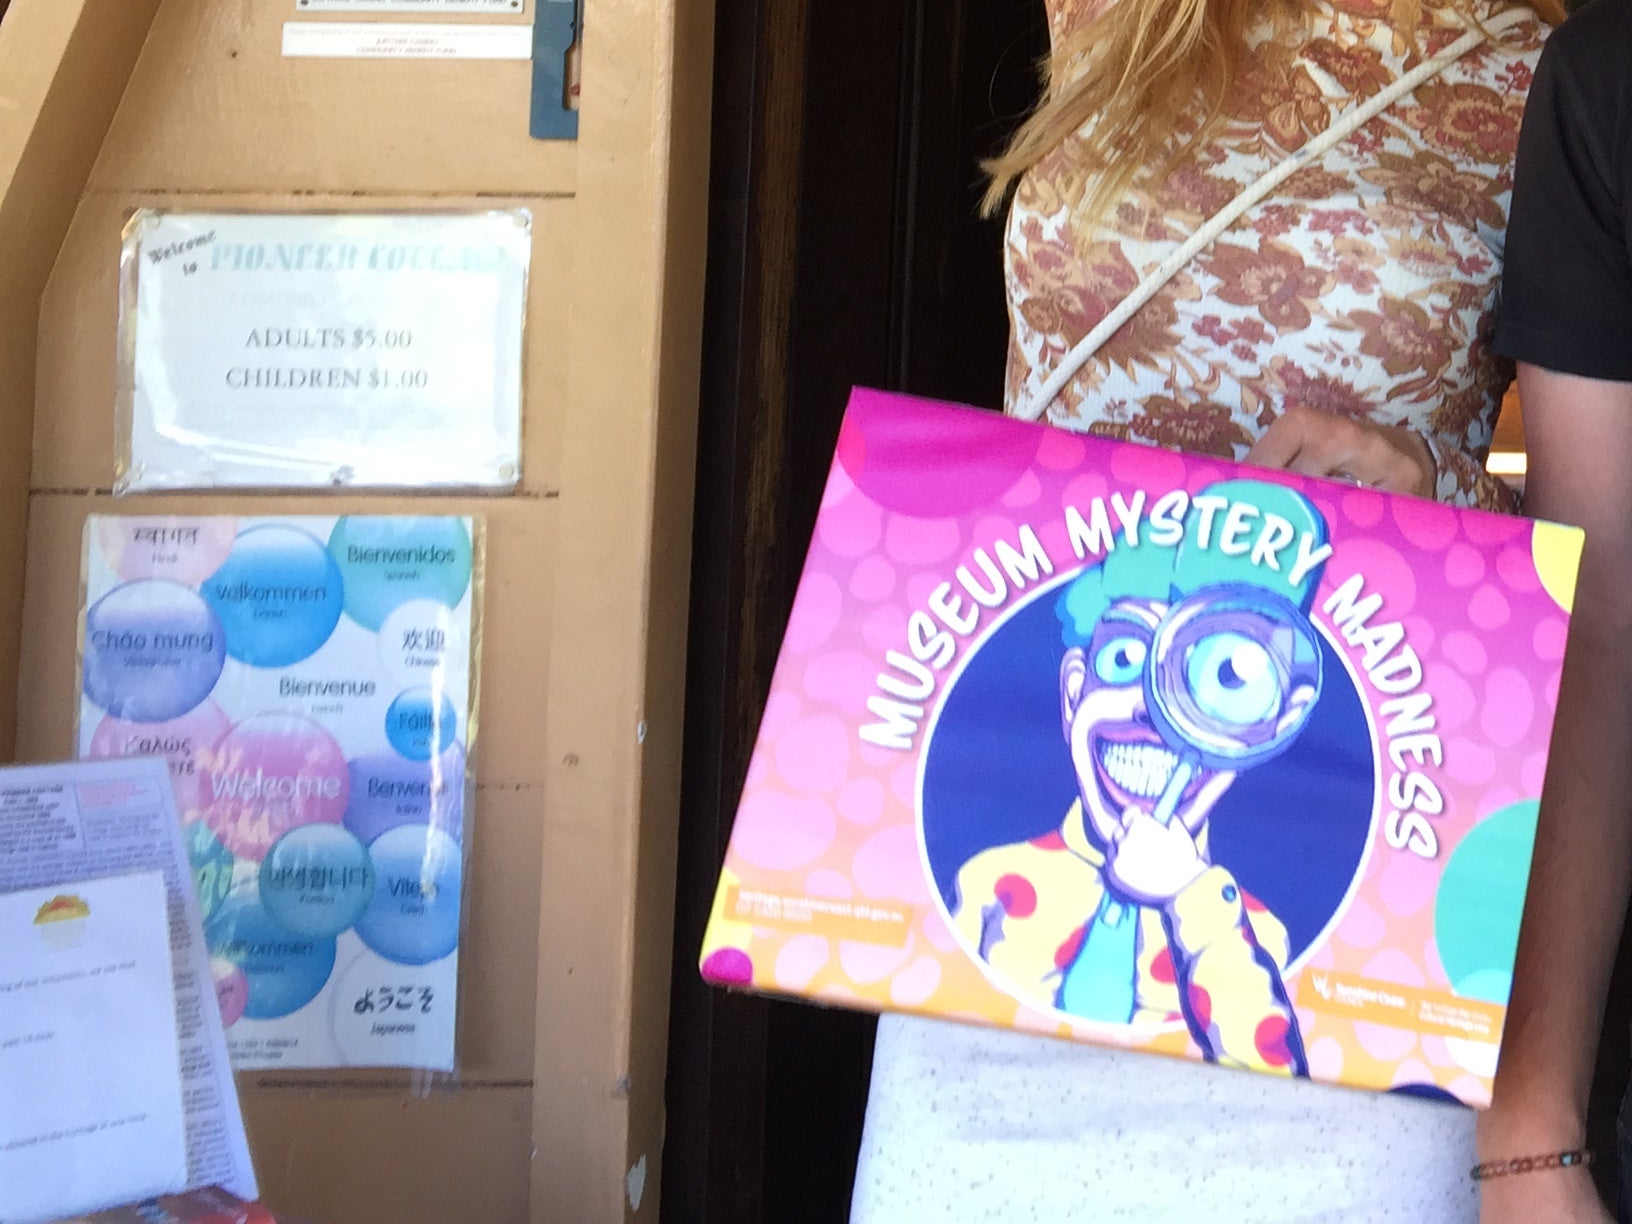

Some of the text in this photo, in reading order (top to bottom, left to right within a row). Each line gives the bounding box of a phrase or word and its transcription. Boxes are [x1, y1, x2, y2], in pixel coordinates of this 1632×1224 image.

[148, 230, 217, 264] Welcome
[182, 261, 198, 276] to
[210, 243, 358, 272] PIONEER
[244, 326, 412, 350] ADULTS $5.00
[225, 365, 428, 390] CHILDREN $1.00
[347, 544, 456, 565] Bienvenidos
[278, 677, 376, 698] Bienvenue
[857, 489, 1444, 859] MUSEUM MYSTERY MADNESS
[210, 767, 341, 800] Welcome
[354, 985, 434, 1015] ようこそ
